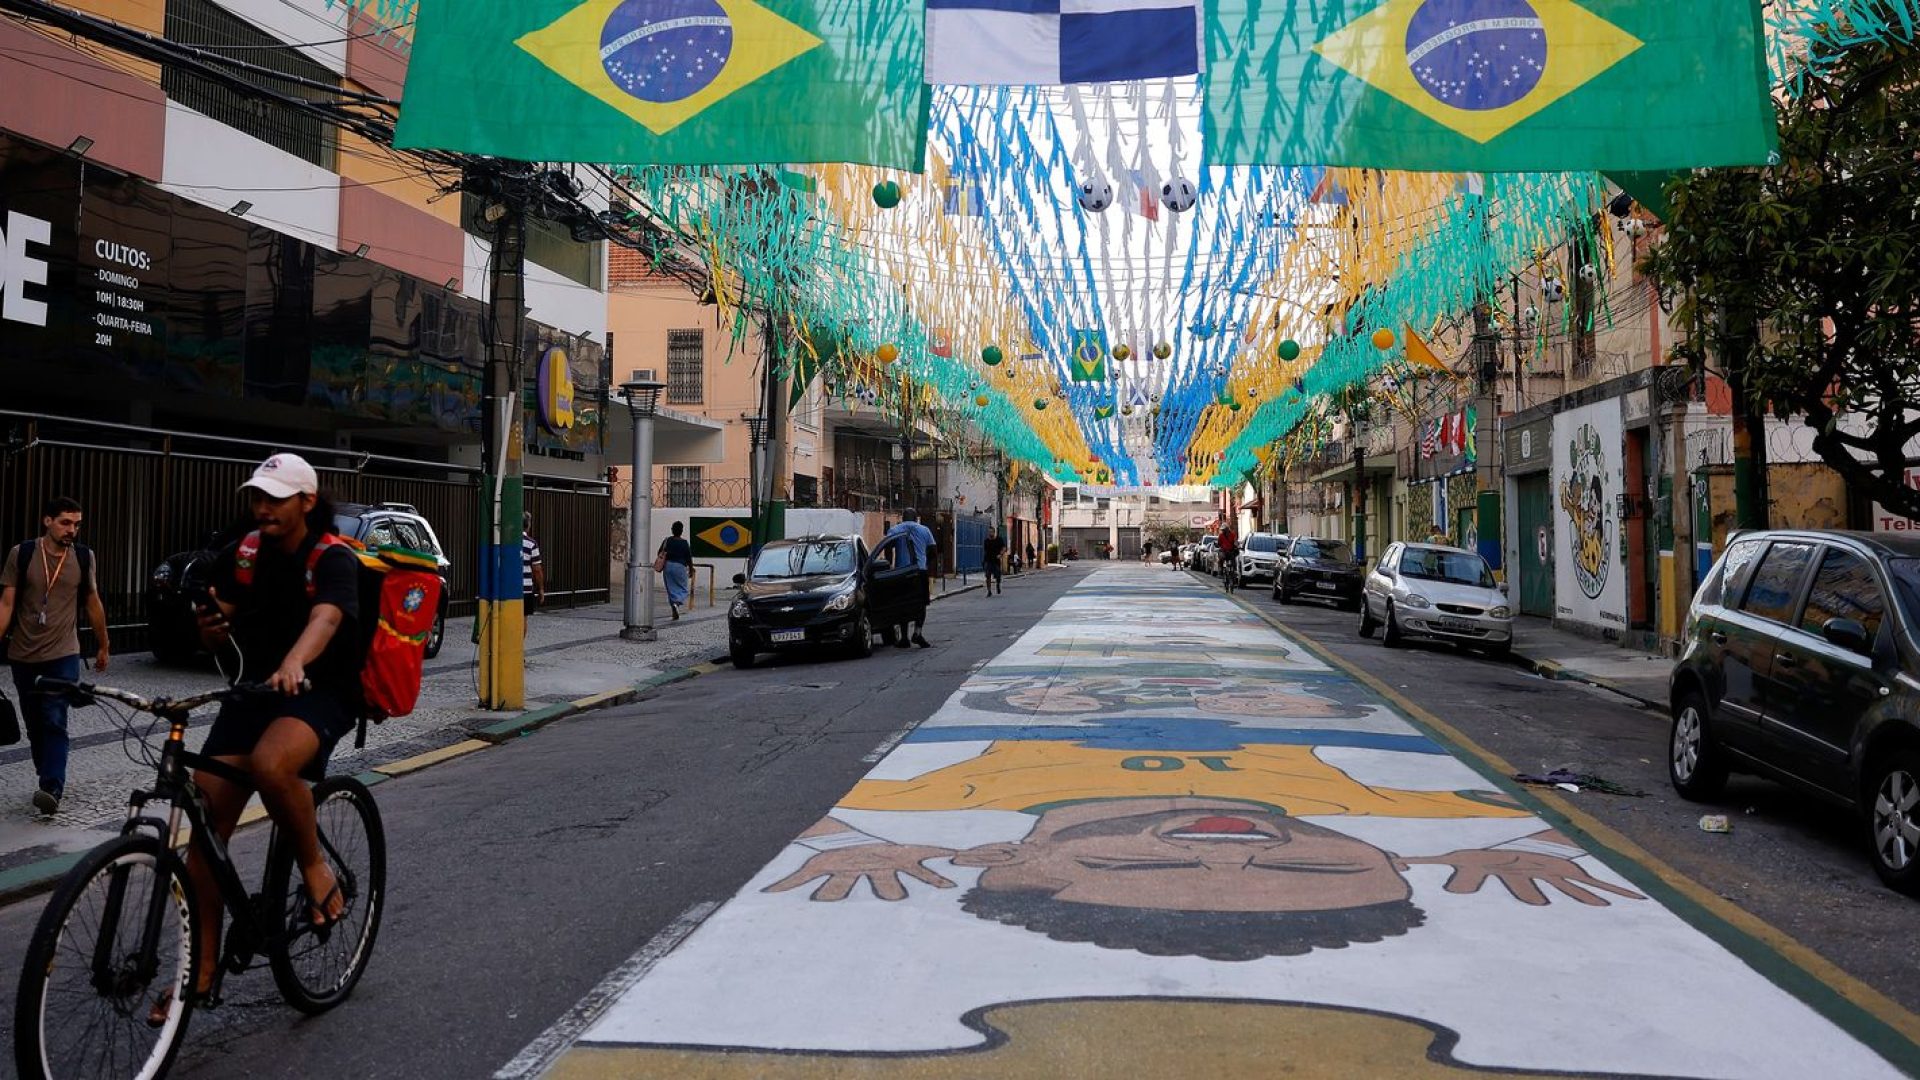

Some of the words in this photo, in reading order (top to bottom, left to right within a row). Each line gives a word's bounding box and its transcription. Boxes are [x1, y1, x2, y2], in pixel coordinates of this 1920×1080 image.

[95, 238, 151, 271] CULTOS:
[0, 209, 52, 327] E
[99, 269, 139, 289] DOMINGO
[117, 296, 144, 312] 18:30H
[96, 313, 152, 335] QUARTA-FEIRA
[95, 333, 112, 346] 20H
